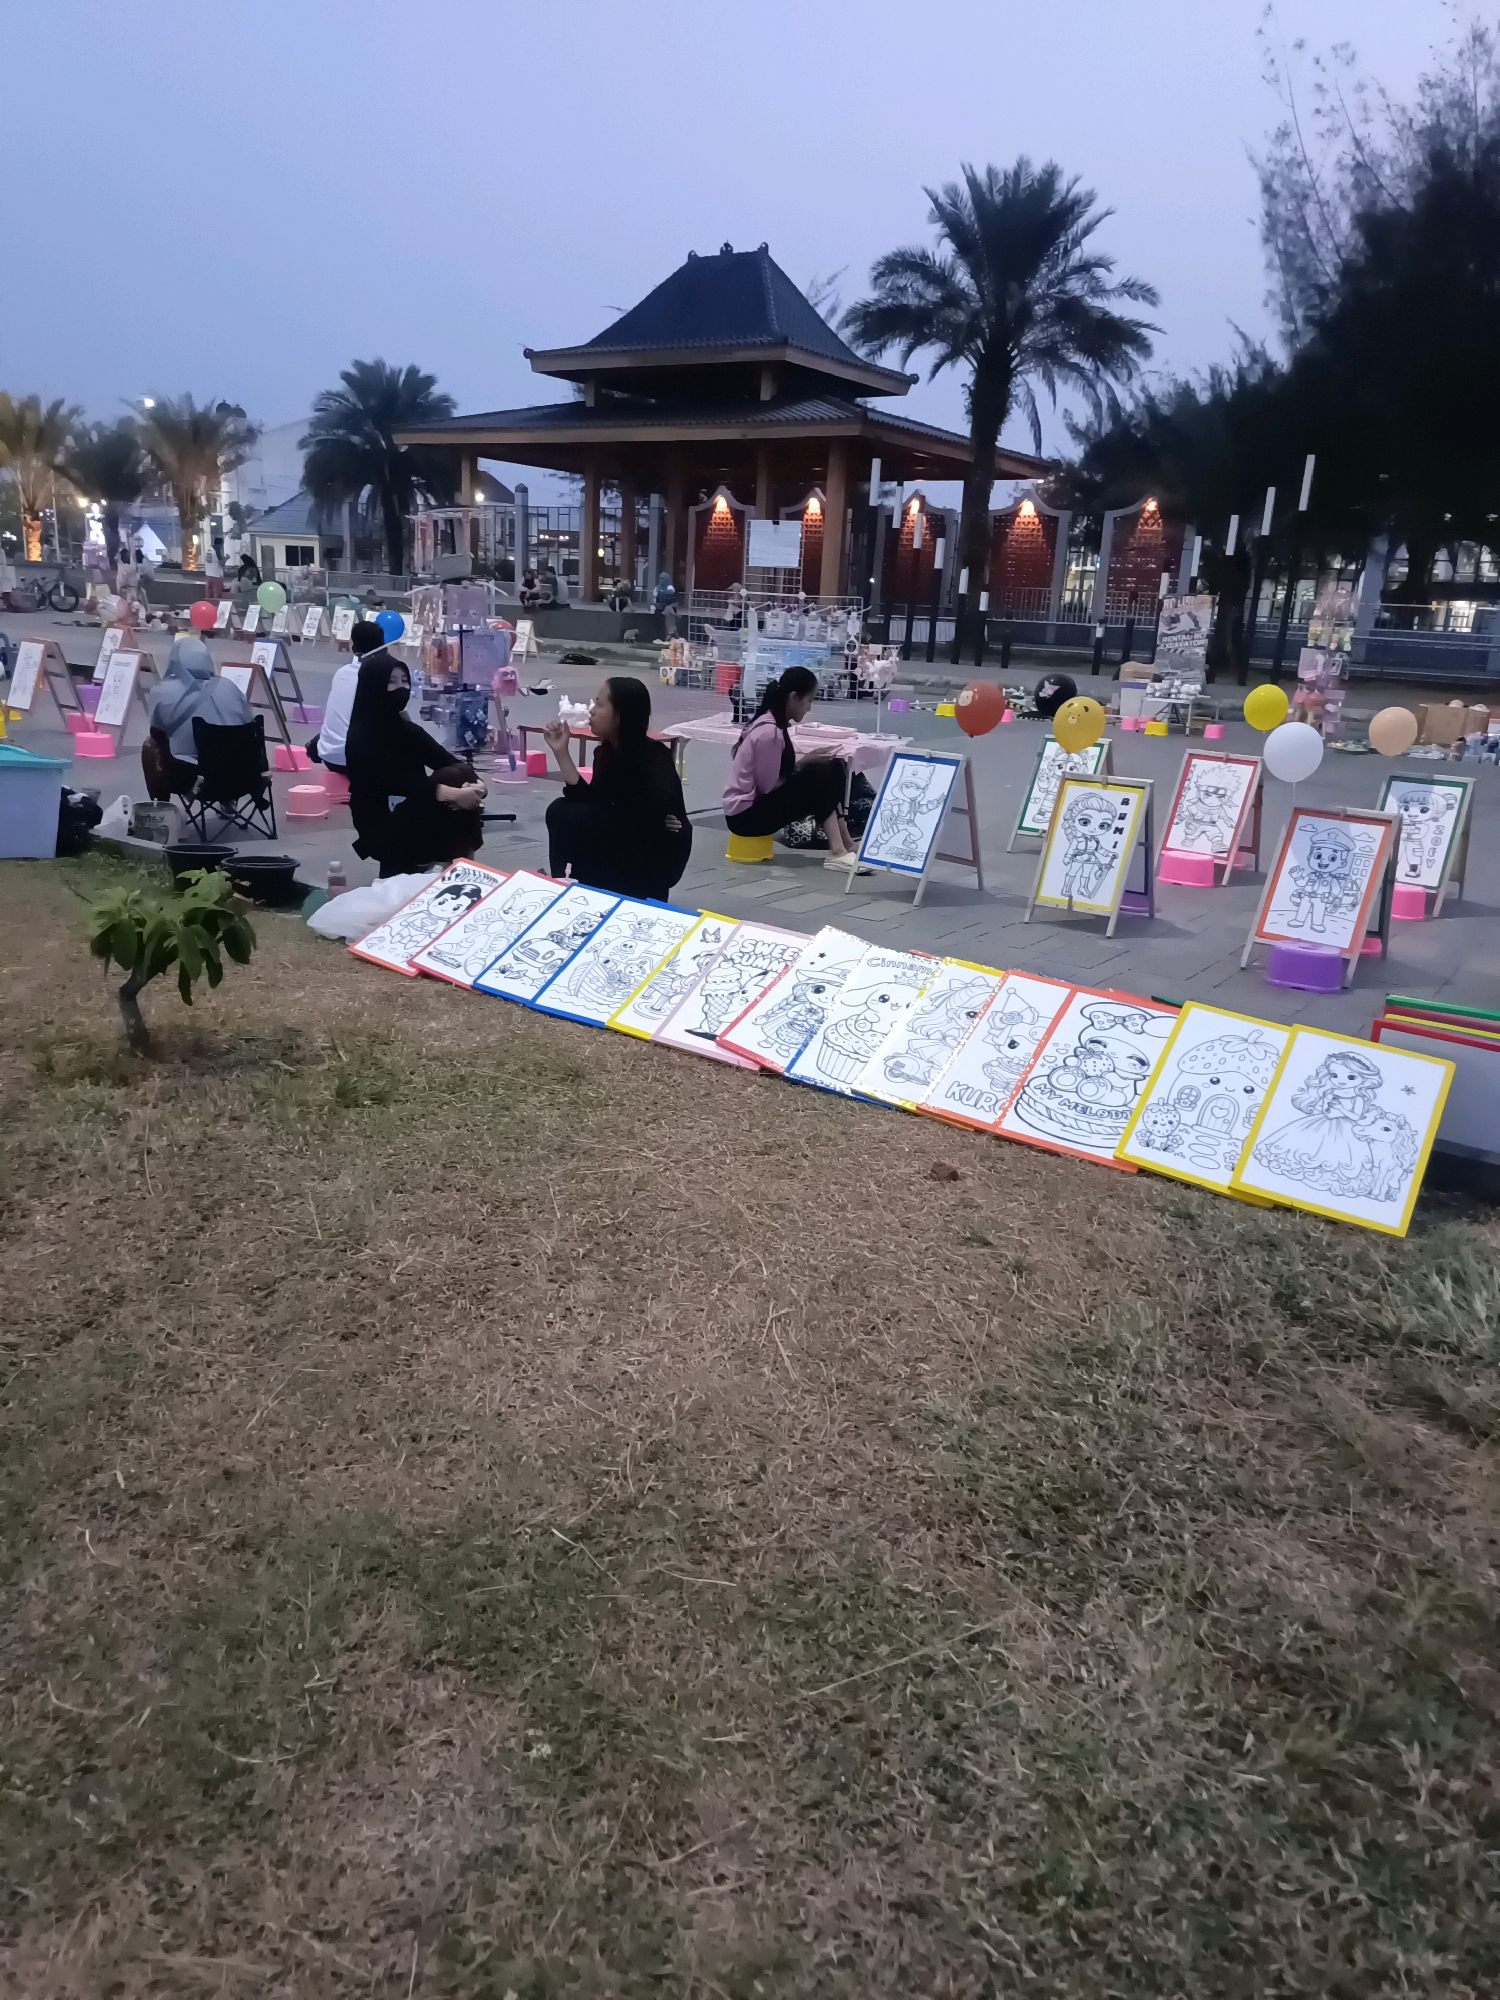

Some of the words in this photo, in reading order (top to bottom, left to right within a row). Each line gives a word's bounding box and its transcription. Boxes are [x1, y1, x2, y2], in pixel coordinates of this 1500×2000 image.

[1160, 640, 1205, 650] EXCAVATOR
[1161, 634, 1192, 643] RENTAL
[1426, 824, 1446, 869] ZOEY
[739, 938, 803, 961] SWEE
[730, 951, 788, 974] SUMM
[1034, 1082, 1064, 1101] MY
